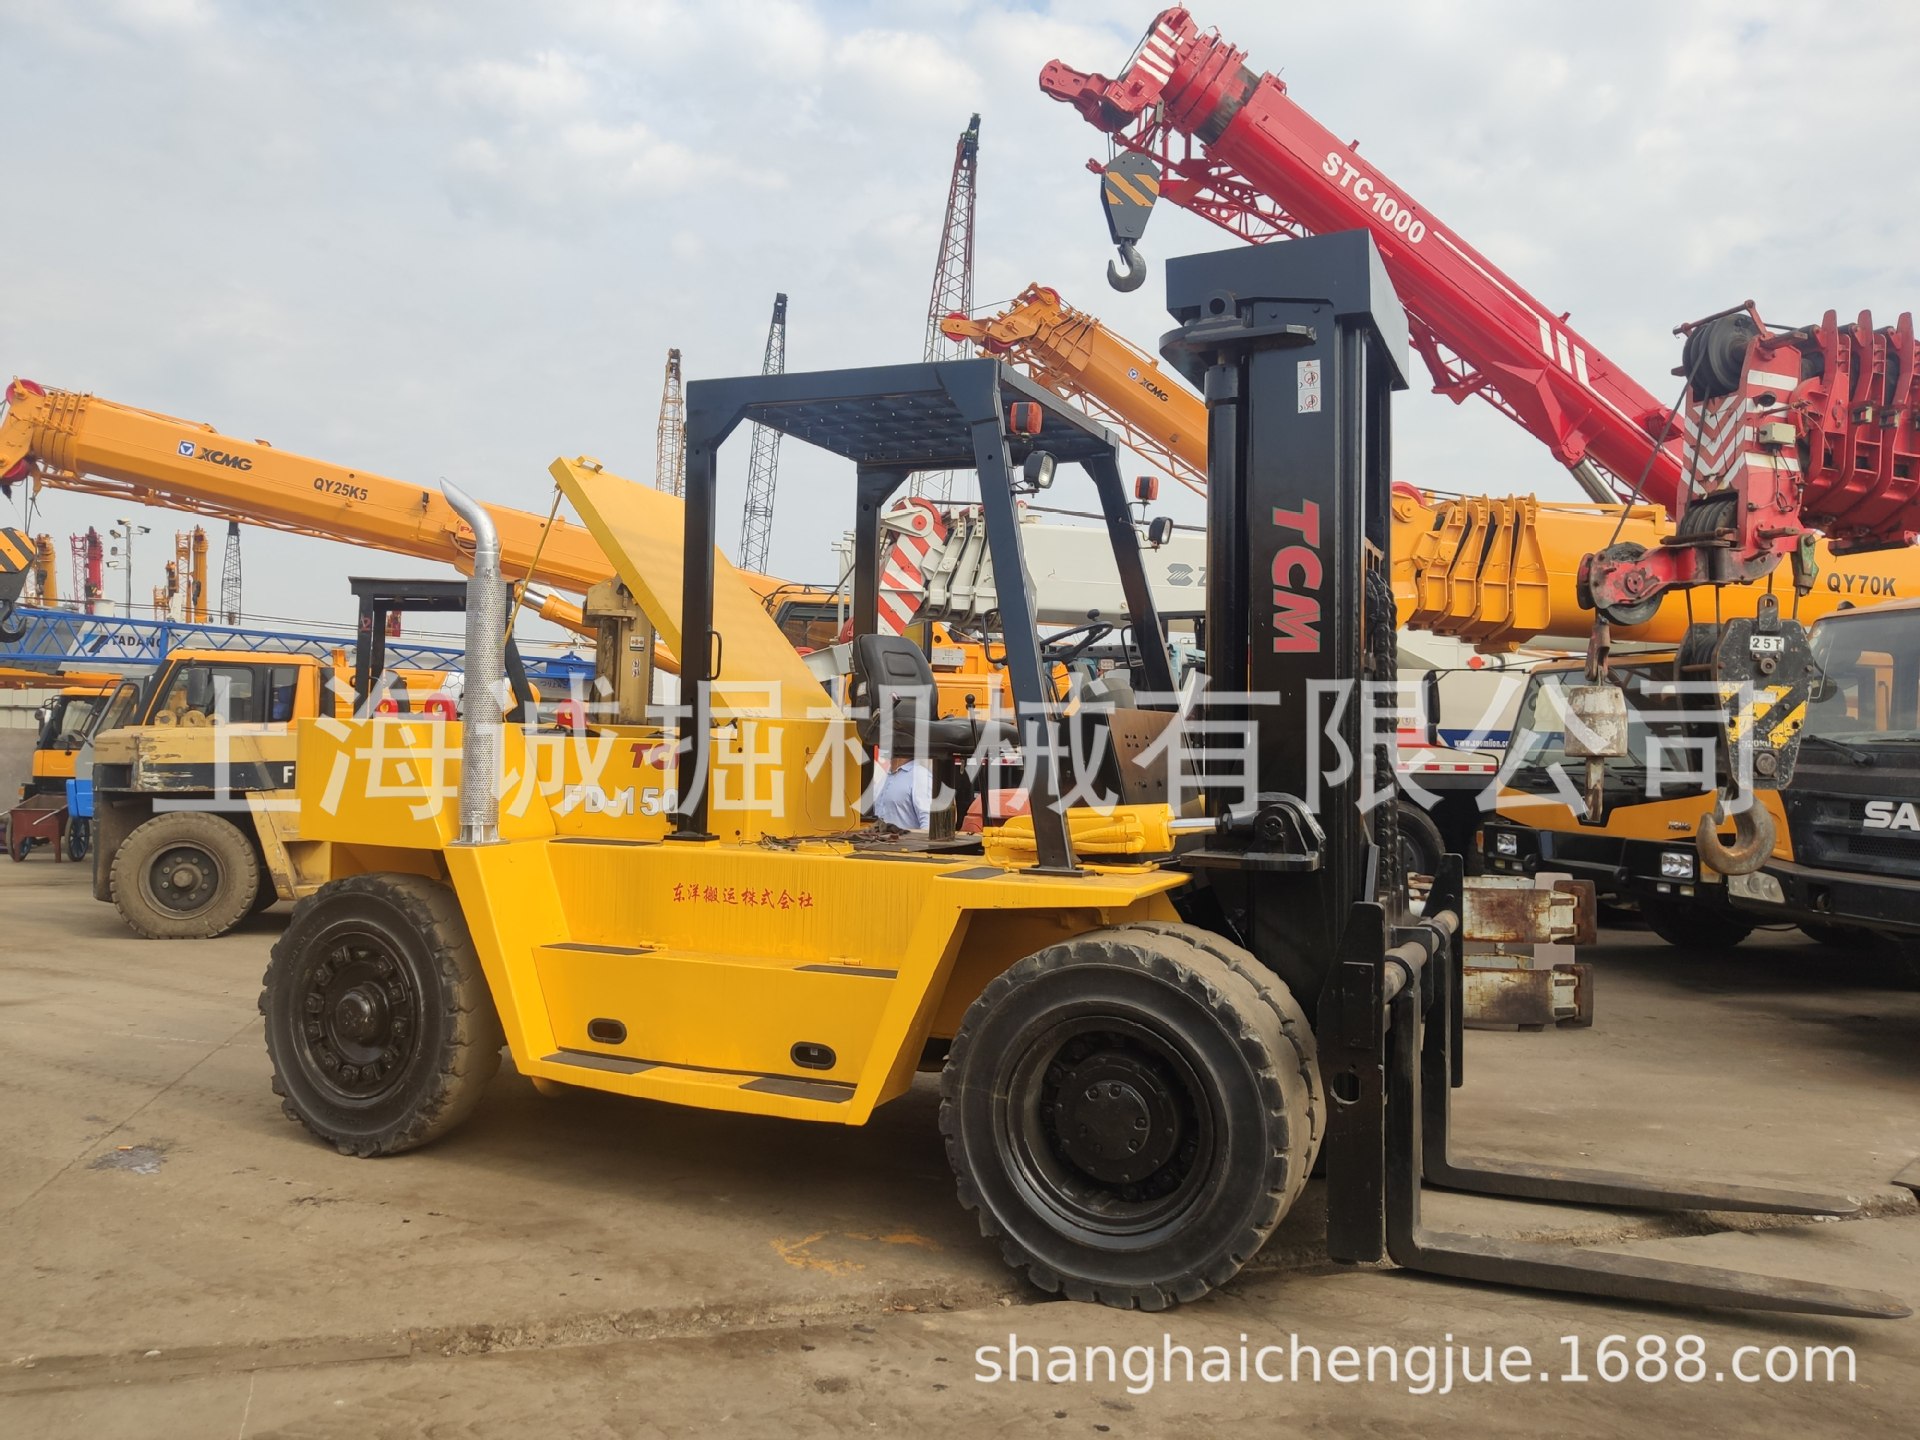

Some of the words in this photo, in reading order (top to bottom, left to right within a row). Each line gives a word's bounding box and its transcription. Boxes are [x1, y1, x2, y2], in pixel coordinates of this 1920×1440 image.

[1322, 152, 1426, 244] STC1000
[1139, 377, 1169, 402] XCMG
[197, 447, 252, 471] XCMG
[313, 477, 368, 501] QY25K5
[1272, 498, 1323, 653] TCM
[1827, 572, 1896, 597] QY70K
[1752, 637, 1782, 650] 25T
[563, 784, 679, 817] FD-150
[1863, 800, 1920, 831] SA
[673, 882, 814, 910] 东洋搬运株式会社
